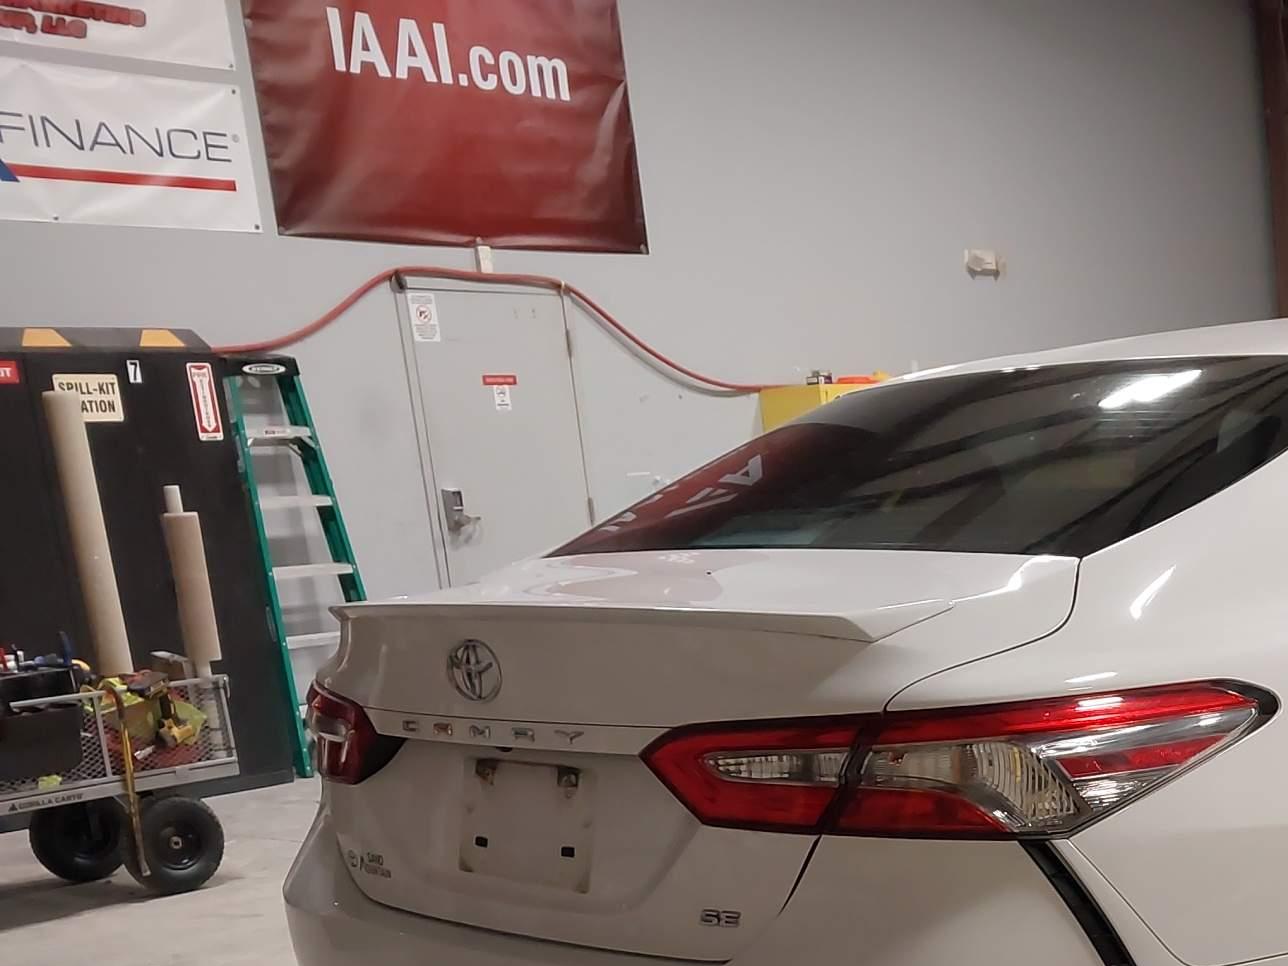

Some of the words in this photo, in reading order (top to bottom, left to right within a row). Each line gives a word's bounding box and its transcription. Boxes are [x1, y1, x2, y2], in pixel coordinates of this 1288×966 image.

[326, 7, 570, 101] IAAI.com
[0, 111, 232, 163] FINANCE
[129, 361, 138, 381] 7
[58, 382, 116, 395] SPILL-KIT
[80, 400, 116, 413] ATION
[402, 720, 585, 745] CAMRY
[700, 909, 741, 927] SE
